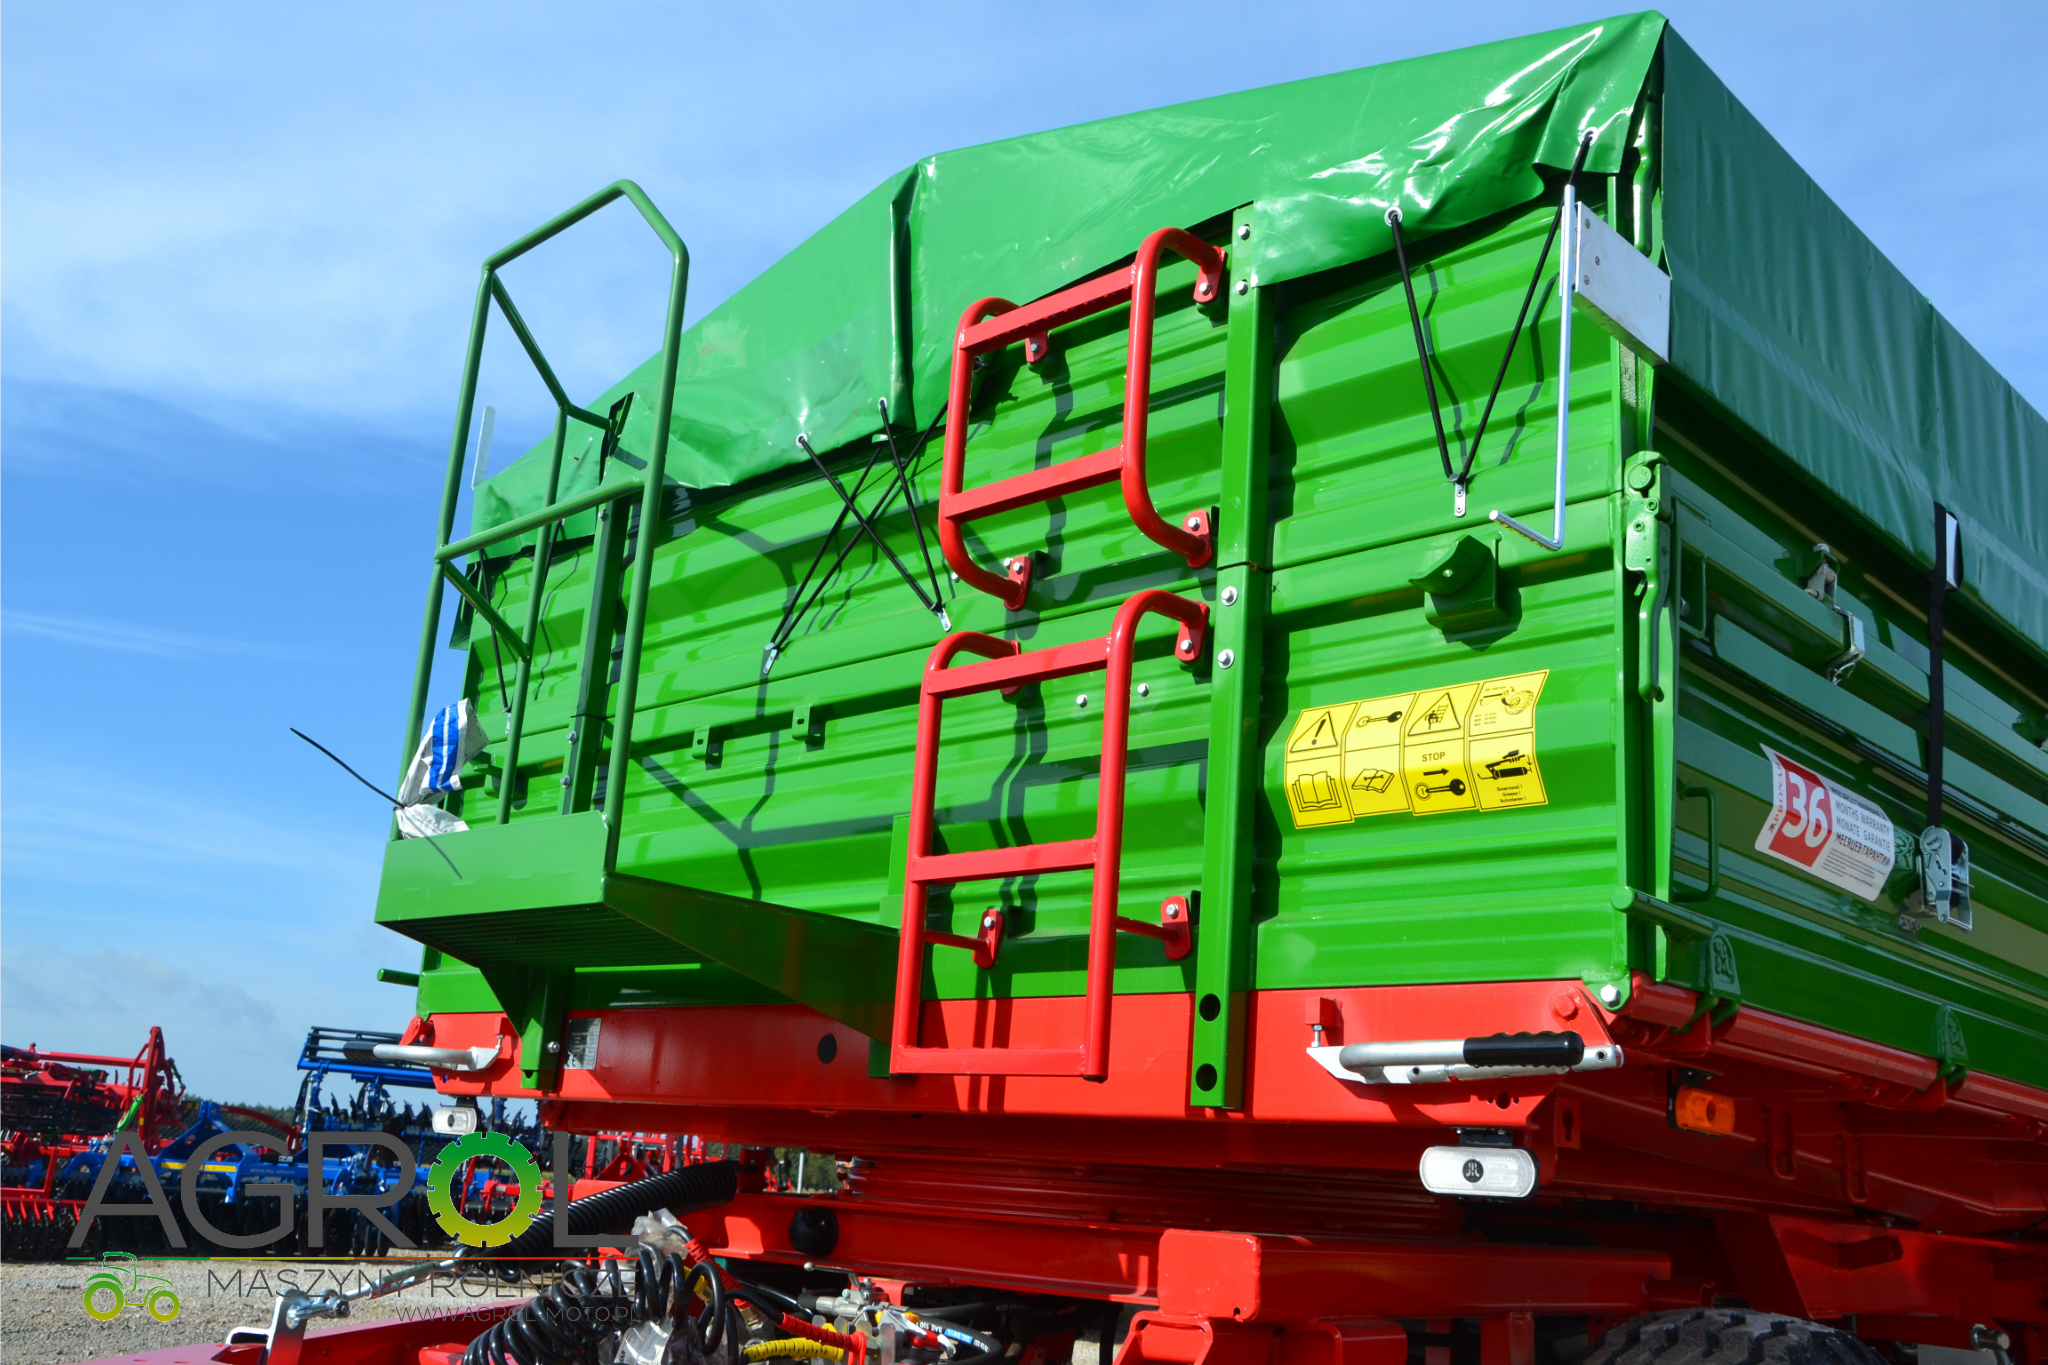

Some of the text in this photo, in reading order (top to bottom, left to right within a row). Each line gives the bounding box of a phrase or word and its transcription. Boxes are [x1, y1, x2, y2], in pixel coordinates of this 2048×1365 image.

[1422, 751, 1446, 762] STOP
[1781, 771, 1828, 848] 36
[1835, 800, 1859, 821] MONTHS
[1860, 812, 1890, 836] WARRANTY
[1836, 816, 1891, 853] MONATE GARANTIE
